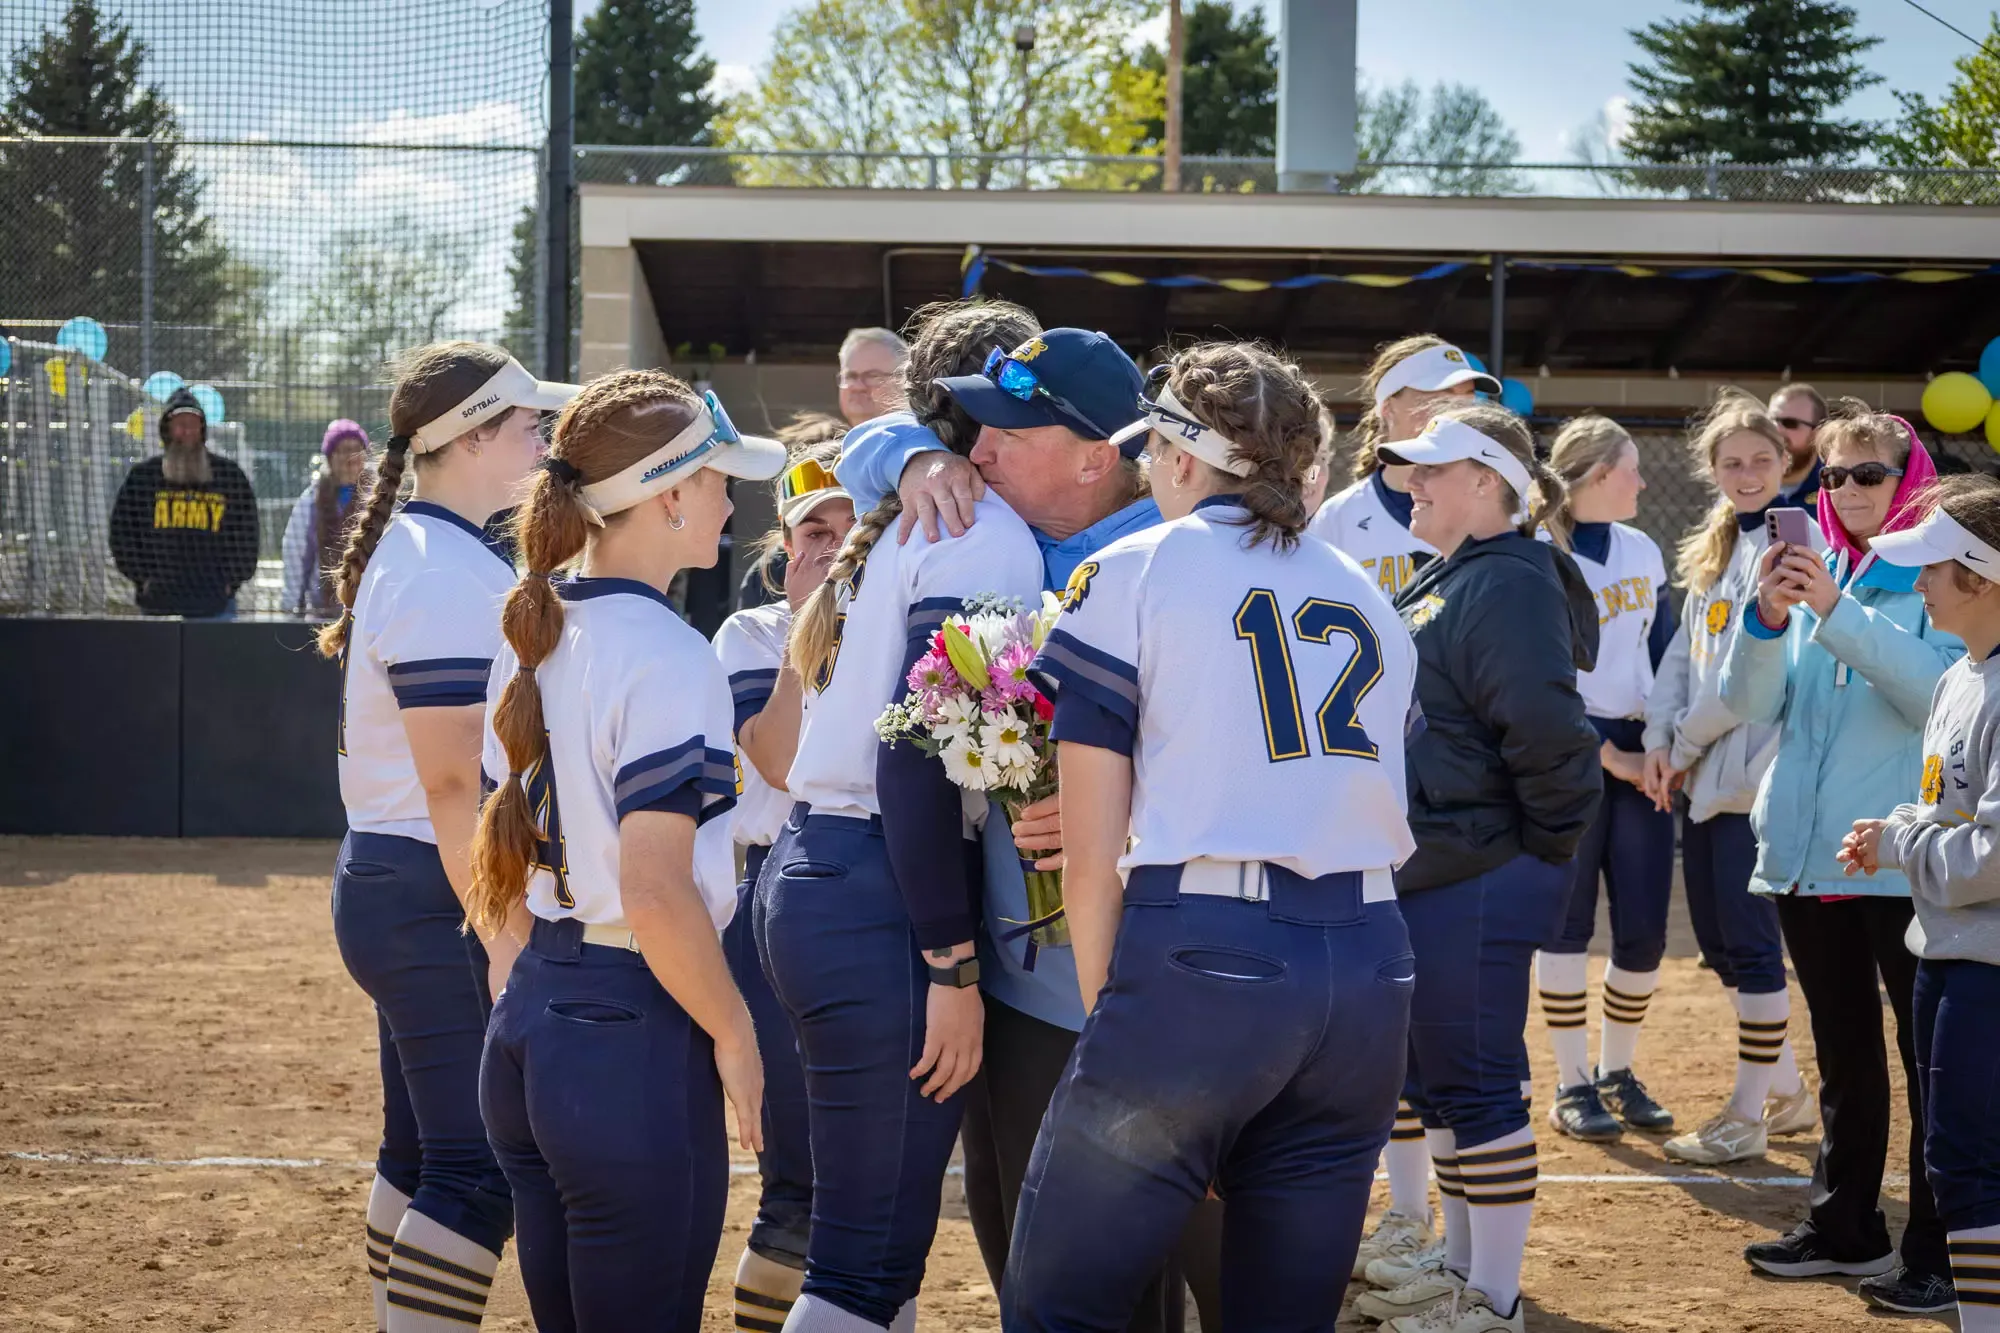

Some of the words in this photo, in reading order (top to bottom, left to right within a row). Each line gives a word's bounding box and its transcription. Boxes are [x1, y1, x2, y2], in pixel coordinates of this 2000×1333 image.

[462, 394, 500, 418] SOFTBALL
[1180, 423, 1201, 442] 12
[154, 500, 225, 532] ARMY
[1232, 587, 1385, 763] 12
